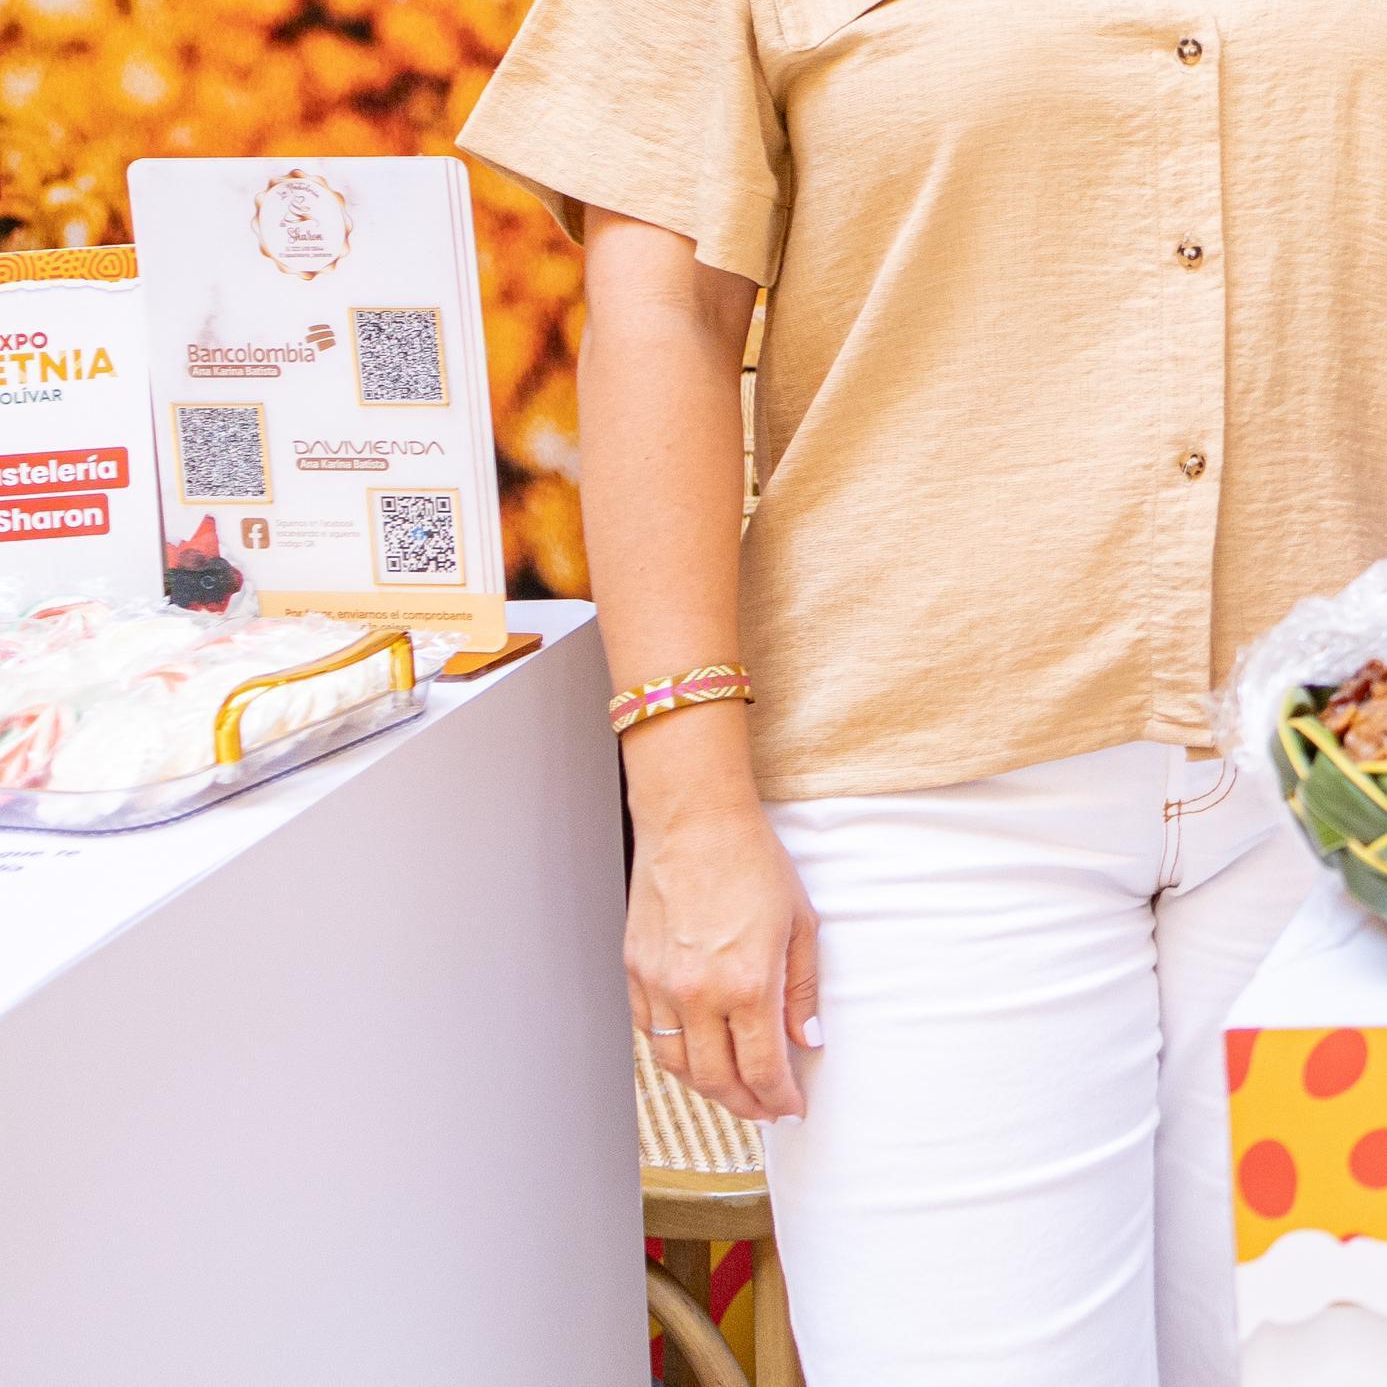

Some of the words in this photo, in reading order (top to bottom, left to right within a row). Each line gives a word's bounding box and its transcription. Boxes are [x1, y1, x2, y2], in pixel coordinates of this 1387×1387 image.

[187, 342, 316, 363] Bancolombia
[292, 440, 445, 455] DAVIVIENDA
[0, 454, 118, 487] stelería
[402, 610, 474, 622] comprobante
